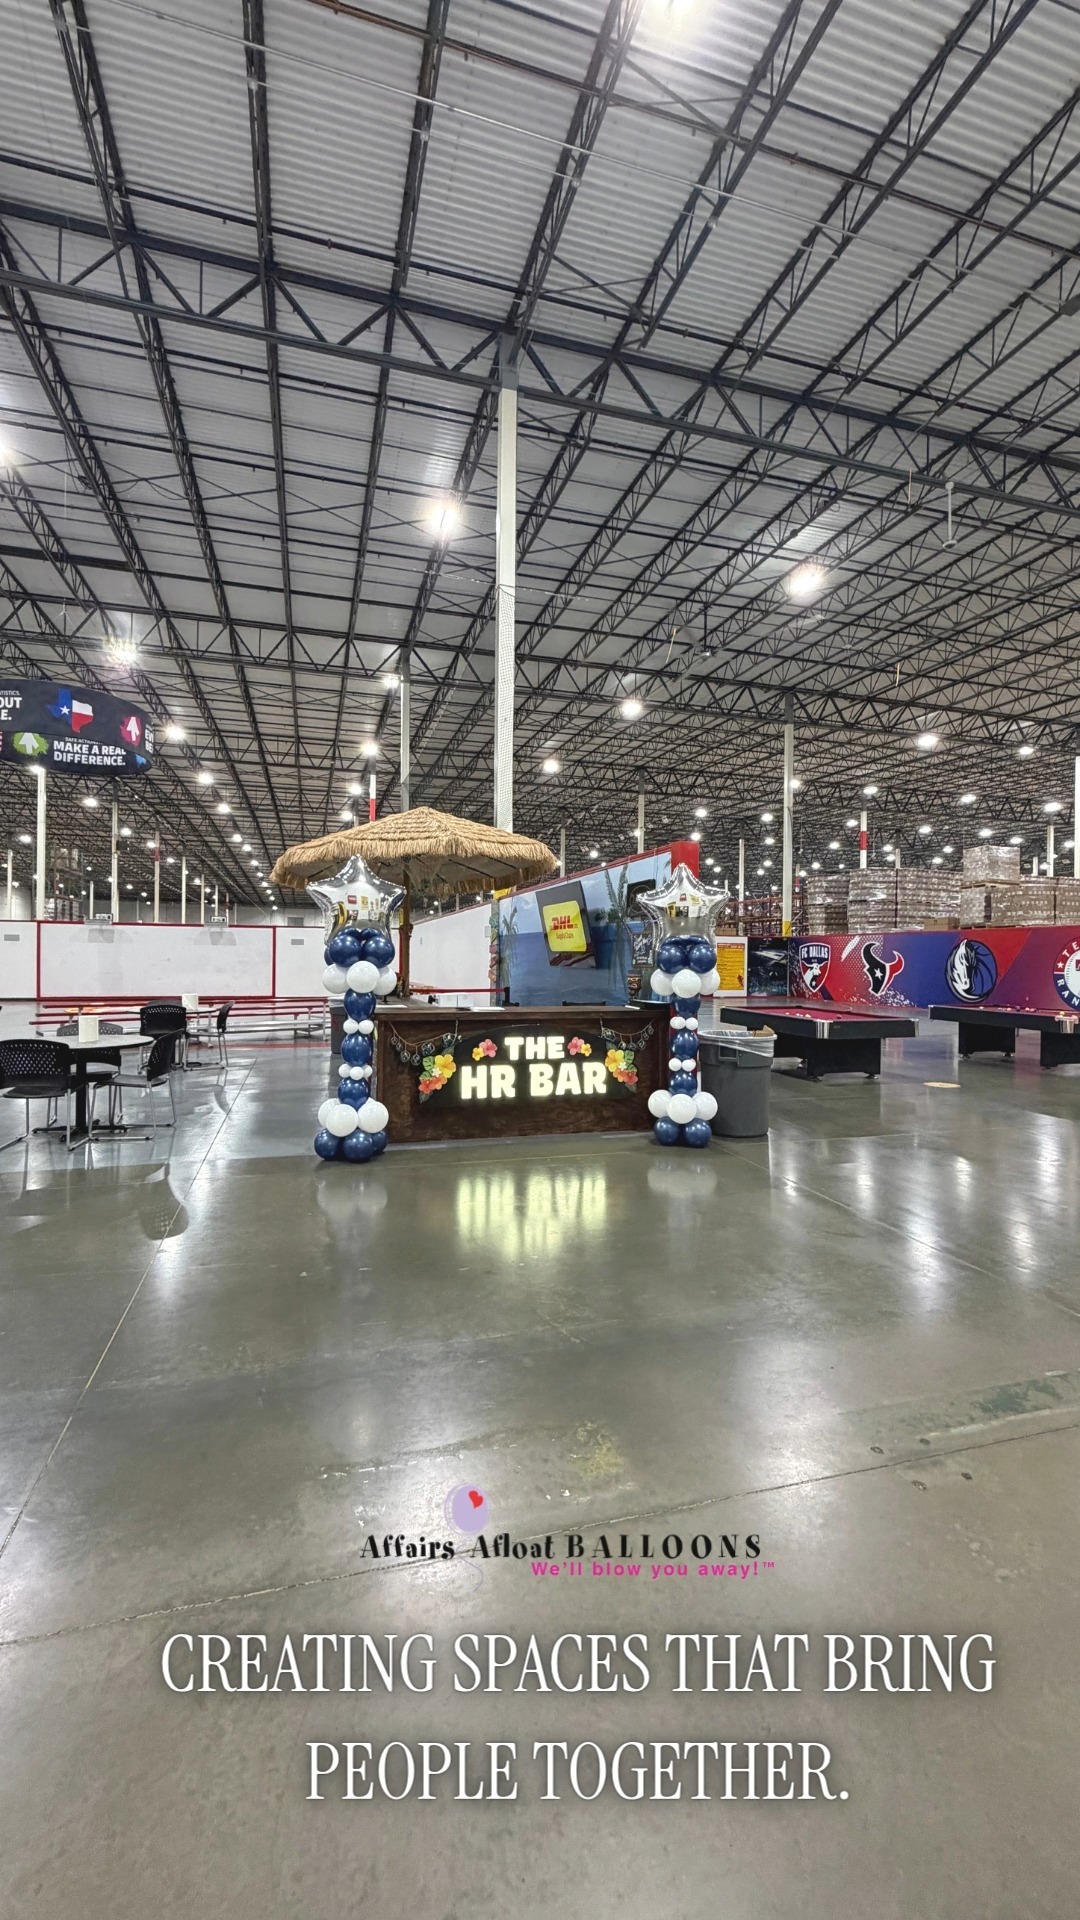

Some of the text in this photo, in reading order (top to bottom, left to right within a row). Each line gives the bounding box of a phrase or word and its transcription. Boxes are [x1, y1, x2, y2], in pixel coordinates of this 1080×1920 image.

[53, 740, 127, 756] MAKE A REAL
[53, 751, 126, 766] DIFFERENCE.
[551, 915, 574, 931] DHL
[801, 946, 828, 959] FC DALLAS
[504, 1035, 565, 1061] THE
[460, 1062, 607, 1100] HR BAR
